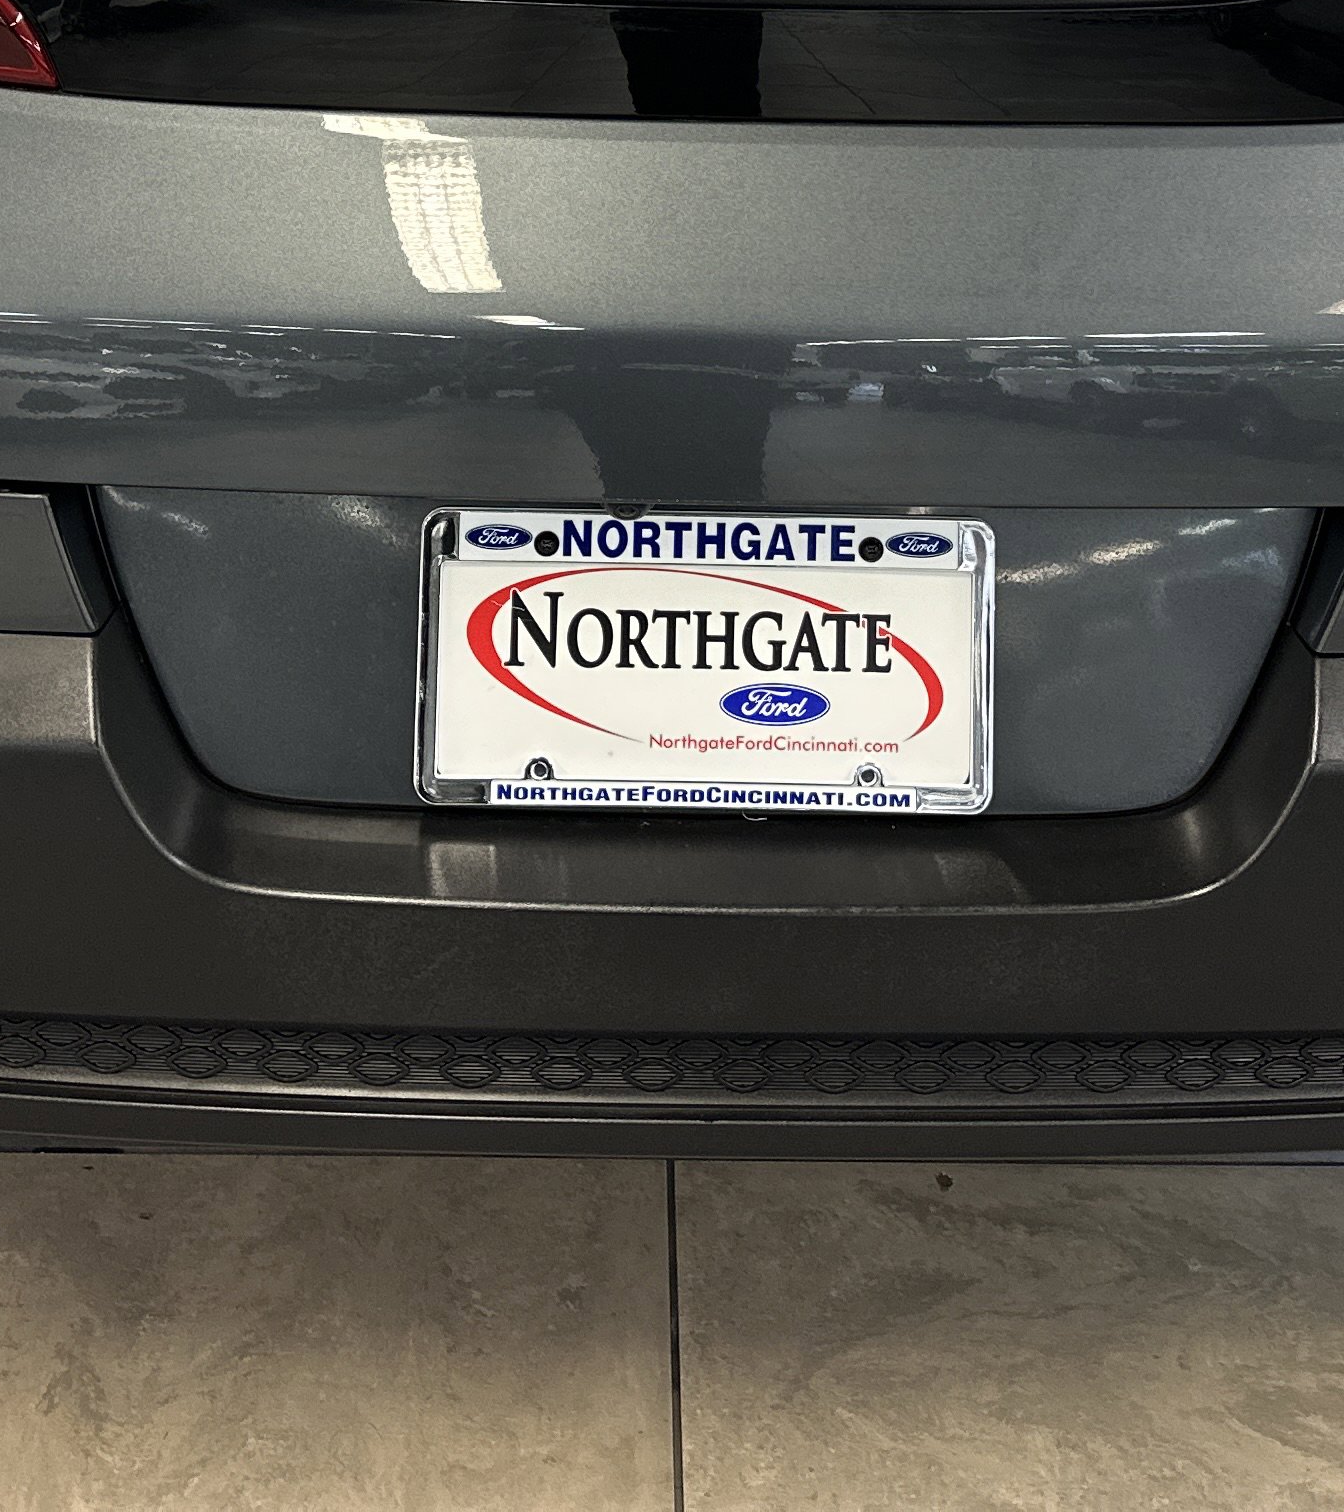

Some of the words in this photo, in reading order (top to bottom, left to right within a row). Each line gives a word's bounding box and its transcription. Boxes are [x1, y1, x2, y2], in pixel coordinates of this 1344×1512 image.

[478, 528, 519, 545] Ford
[561, 519, 857, 563] NORTHGATE
[898, 535, 940, 553] Ford
[740, 688, 809, 718] Ford
[649, 733, 900, 755] NorthgateFordCincinnati.com
